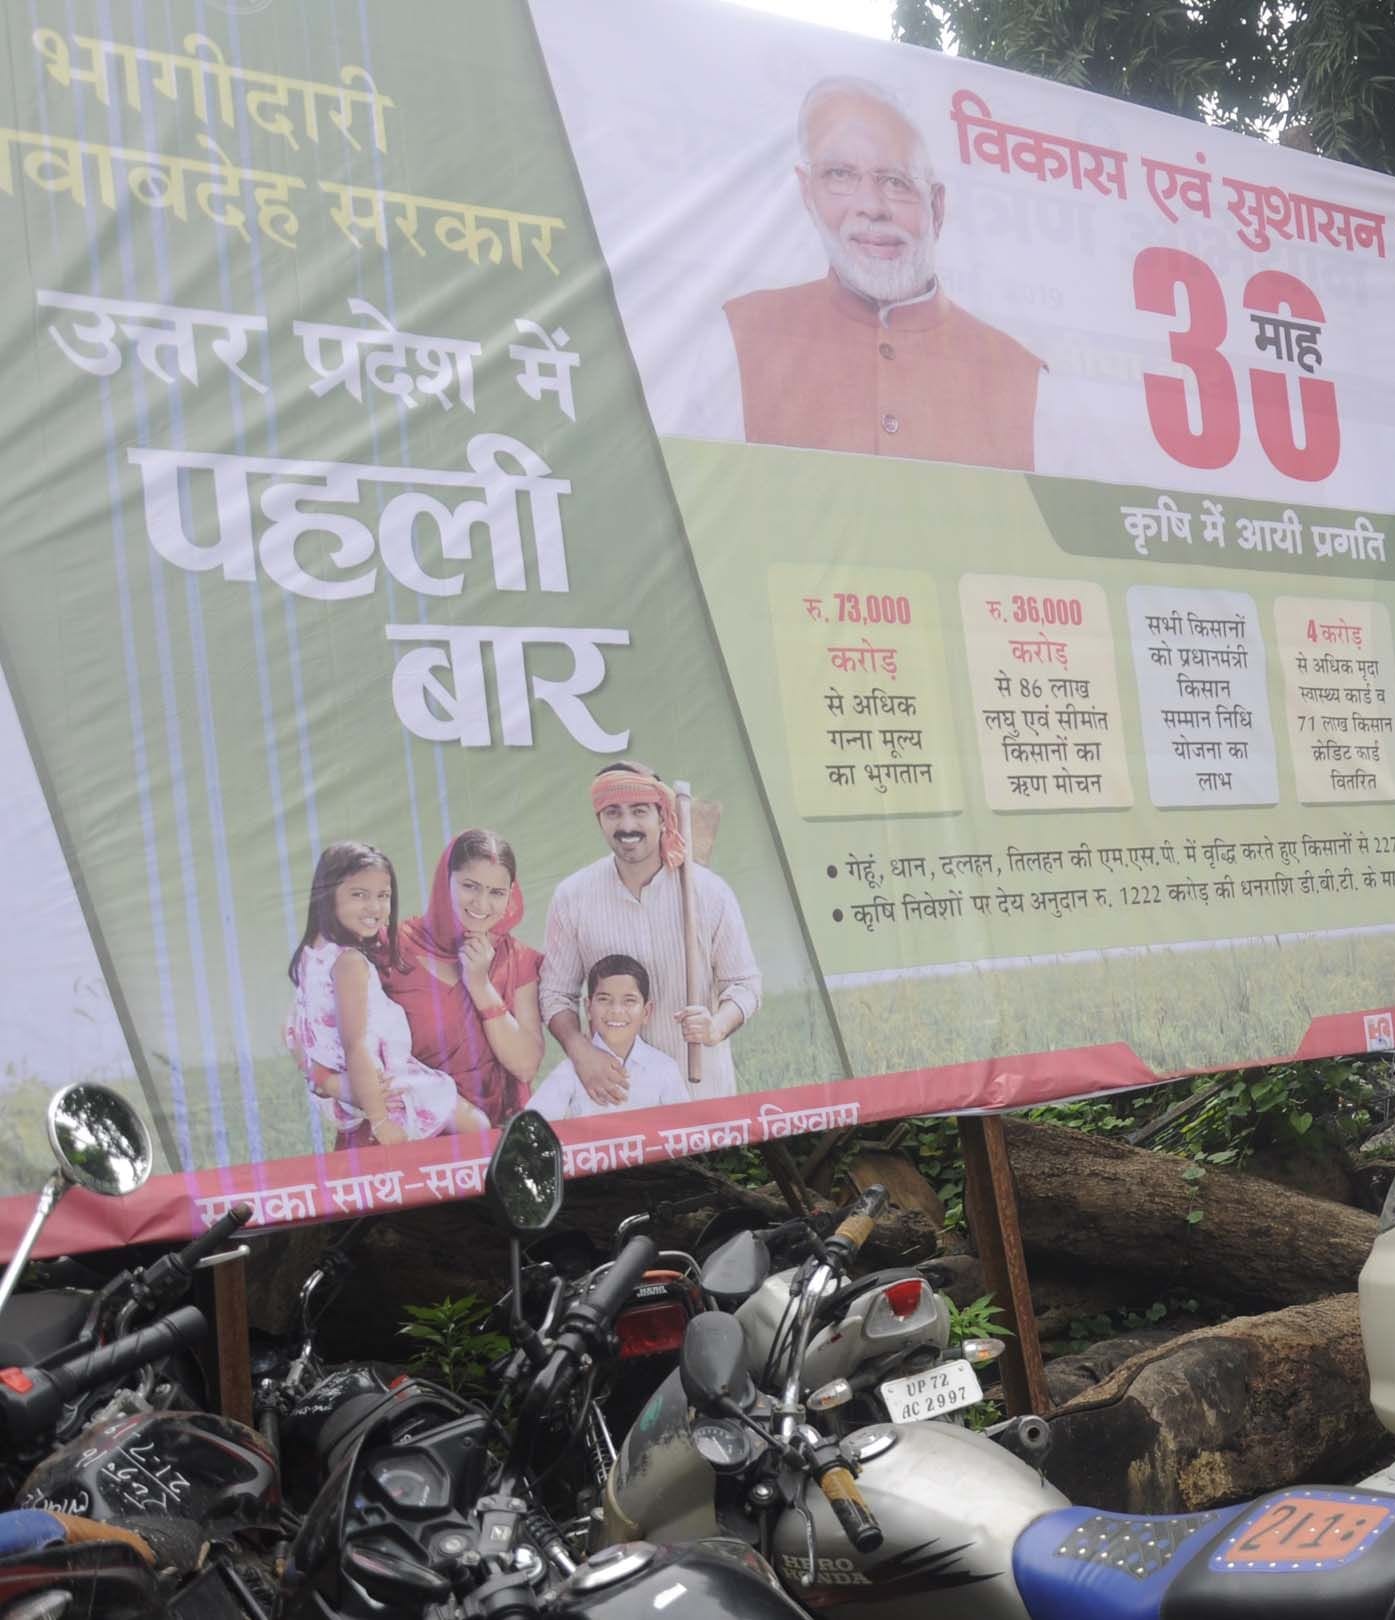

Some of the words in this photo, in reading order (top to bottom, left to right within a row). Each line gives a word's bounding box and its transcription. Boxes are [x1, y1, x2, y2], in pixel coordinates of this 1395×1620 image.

[33, 28, 396, 153] भागीदारी
[951, 90, 1128, 200] विकास
[1141, 152, 1211, 224] एवं
[1223, 176, 1386, 258] सुशासन
[0, 127, 306, 248] वाबदेह
[318, 180, 566, 275] सरकार
[37, 289, 268, 394] उत्तर
[293, 298, 482, 413] प्रदेश
[509, 319, 580, 422] में
[1250, 313, 1324, 374] माह
[1133, 246, 1342, 482] 30
[127, 433, 572, 601] पहली
[1120, 495, 1193, 555] कृषि
[1200, 500, 1225, 548] में
[1236, 508, 1303, 555] आयी
[1311, 516, 1386, 562] प्रगति
[803, 598, 830, 623] रु.
[834, 593, 912, 625] 73,000
[986, 601, 1008, 623] रु.
[1012, 595, 1083, 627] 36,000
[1145, 610, 1182, 636] सभी
[1187, 611, 1245, 638] किसानों
[1307, 619, 1318, 643] 4
[1320, 618, 1363, 650] करोड़
[827, 638, 898, 680] करोड़
[1009, 632, 1068, 671] करोड़
[1149, 641, 1172, 666] को
[1177, 644, 1248, 669] प्रधानमंत्री
[1296, 651, 1308, 675] से
[1313, 653, 1354, 675] अधिक
[1356, 660, 1379, 681] मृदा
[385, 624, 630, 754] बार
[994, 670, 1012, 697] से
[1020, 678, 1042, 698] 86
[1049, 679, 1090, 699] लाख
[1177, 672, 1231, 698] किसान
[1344, 683, 1372, 704] कार्ड
[1375, 689, 1386, 704] व
[825, 687, 844, 717] से
[853, 688, 917, 717] अधिक
[1162, 709, 1211, 729] सम्मान
[1215, 704, 1252, 729] निधि
[983, 709, 1019, 738] लघु
[1021, 704, 1050, 736] एवं
[1056, 703, 1109, 731] सीमांत
[1298, 716, 1316, 732] 71
[1321, 716, 1348, 733] लाख
[1352, 712, 1393, 733] किसान
[827, 729, 872, 751] गन्ना
[879, 729, 923, 758] मूल्य
[1002, 735, 1068, 763] किसानों
[1074, 742, 1101, 762] का
[1172, 735, 1222, 760] योजना
[1227, 741, 1248, 760] का
[1312, 739, 1352, 761] क्रेडिट
[1354, 740, 1381, 762] कार्ड
[825, 764, 855, 785] का
[864, 764, 933, 793] भुगतान
[1007, 774, 1047, 797] ऋण
[1053, 767, 1102, 794] मोचन
[1196, 772, 1232, 791] लाभ
[1330, 768, 1377, 791] वितरित
[1007, 845, 1063, 873] तिलहन
[1068, 842, 1093, 869] की
[1184, 838, 1198, 864] में
[1202, 838, 1237, 869] वृद्धि
[1240, 835, 1275, 861] करते
[1277, 841, 1300, 866] हुए
[1301, 832, 1353, 857] किसानों
[1356, 831, 1369, 855] से
[851, 895, 896, 932] कृषि
[902, 890, 964, 921] निवेशों
[970, 895, 991, 916] पर
[995, 886, 1026, 917] देय
[1030, 889, 1088, 918] अनुदान
[1120, 885, 1162, 905] 1222
[1166, 876, 1210, 906] करोड़
[1213, 874, 1236, 900] की
[1240, 871, 1294, 897] धनराशि
[1361, 865, 1378, 888] के
[758, 1102, 861, 1143] विश्वास
[906, 1379, 926, 1398] UP
[930, 1373, 950, 1390] 72
[902, 1401, 920, 1420] AC
[926, 1386, 967, 1412] 2997
[782, 1554, 855, 1571] HERO
[783, 1568, 873, 1585] HNDA
